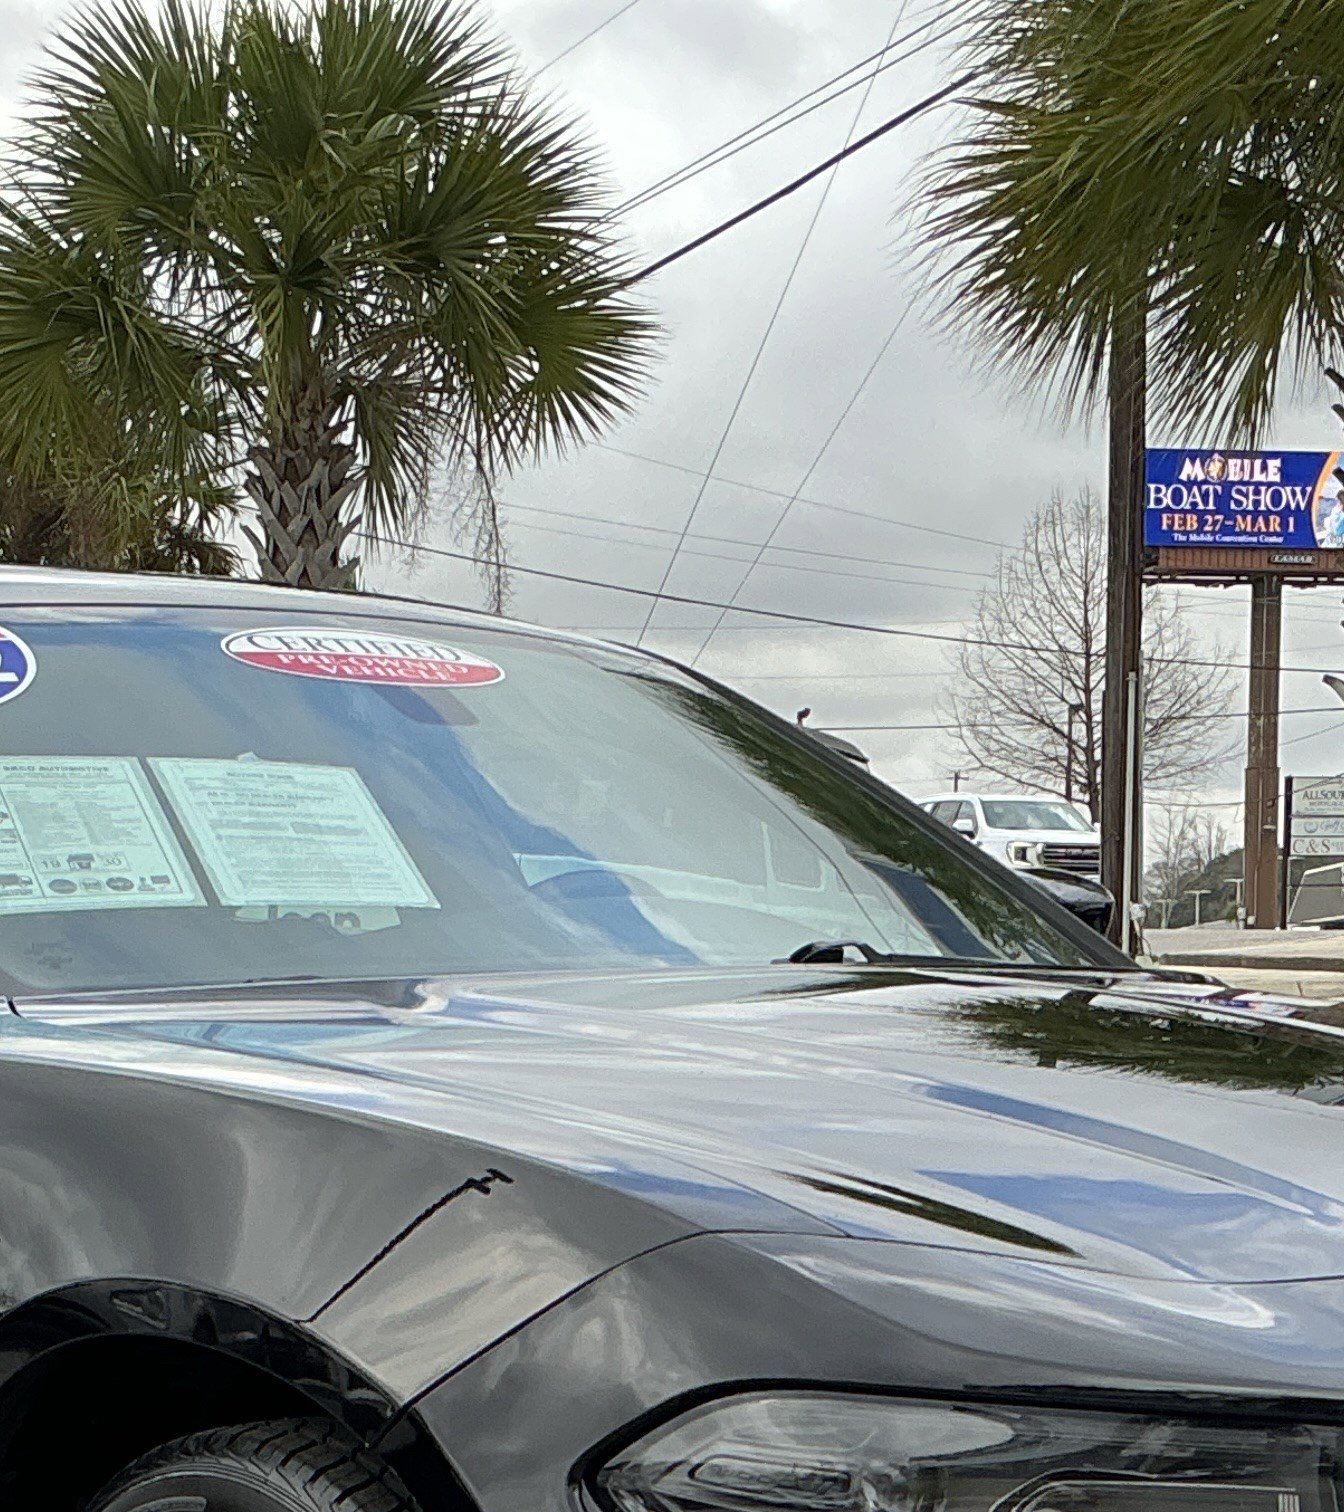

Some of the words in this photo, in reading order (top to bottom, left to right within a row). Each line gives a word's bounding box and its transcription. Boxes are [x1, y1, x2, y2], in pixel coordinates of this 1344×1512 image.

[1178, 454, 1282, 483] MOBILE
[1147, 483, 1222, 511] BOAT
[1230, 485, 1313, 512] SHOW
[1161, 513, 1199, 531] FEB
[247, 634, 462, 662] CERTIFIED
[276, 653, 469, 674] PRE-OWNED
[316, 664, 458, 682] VEHICLE
